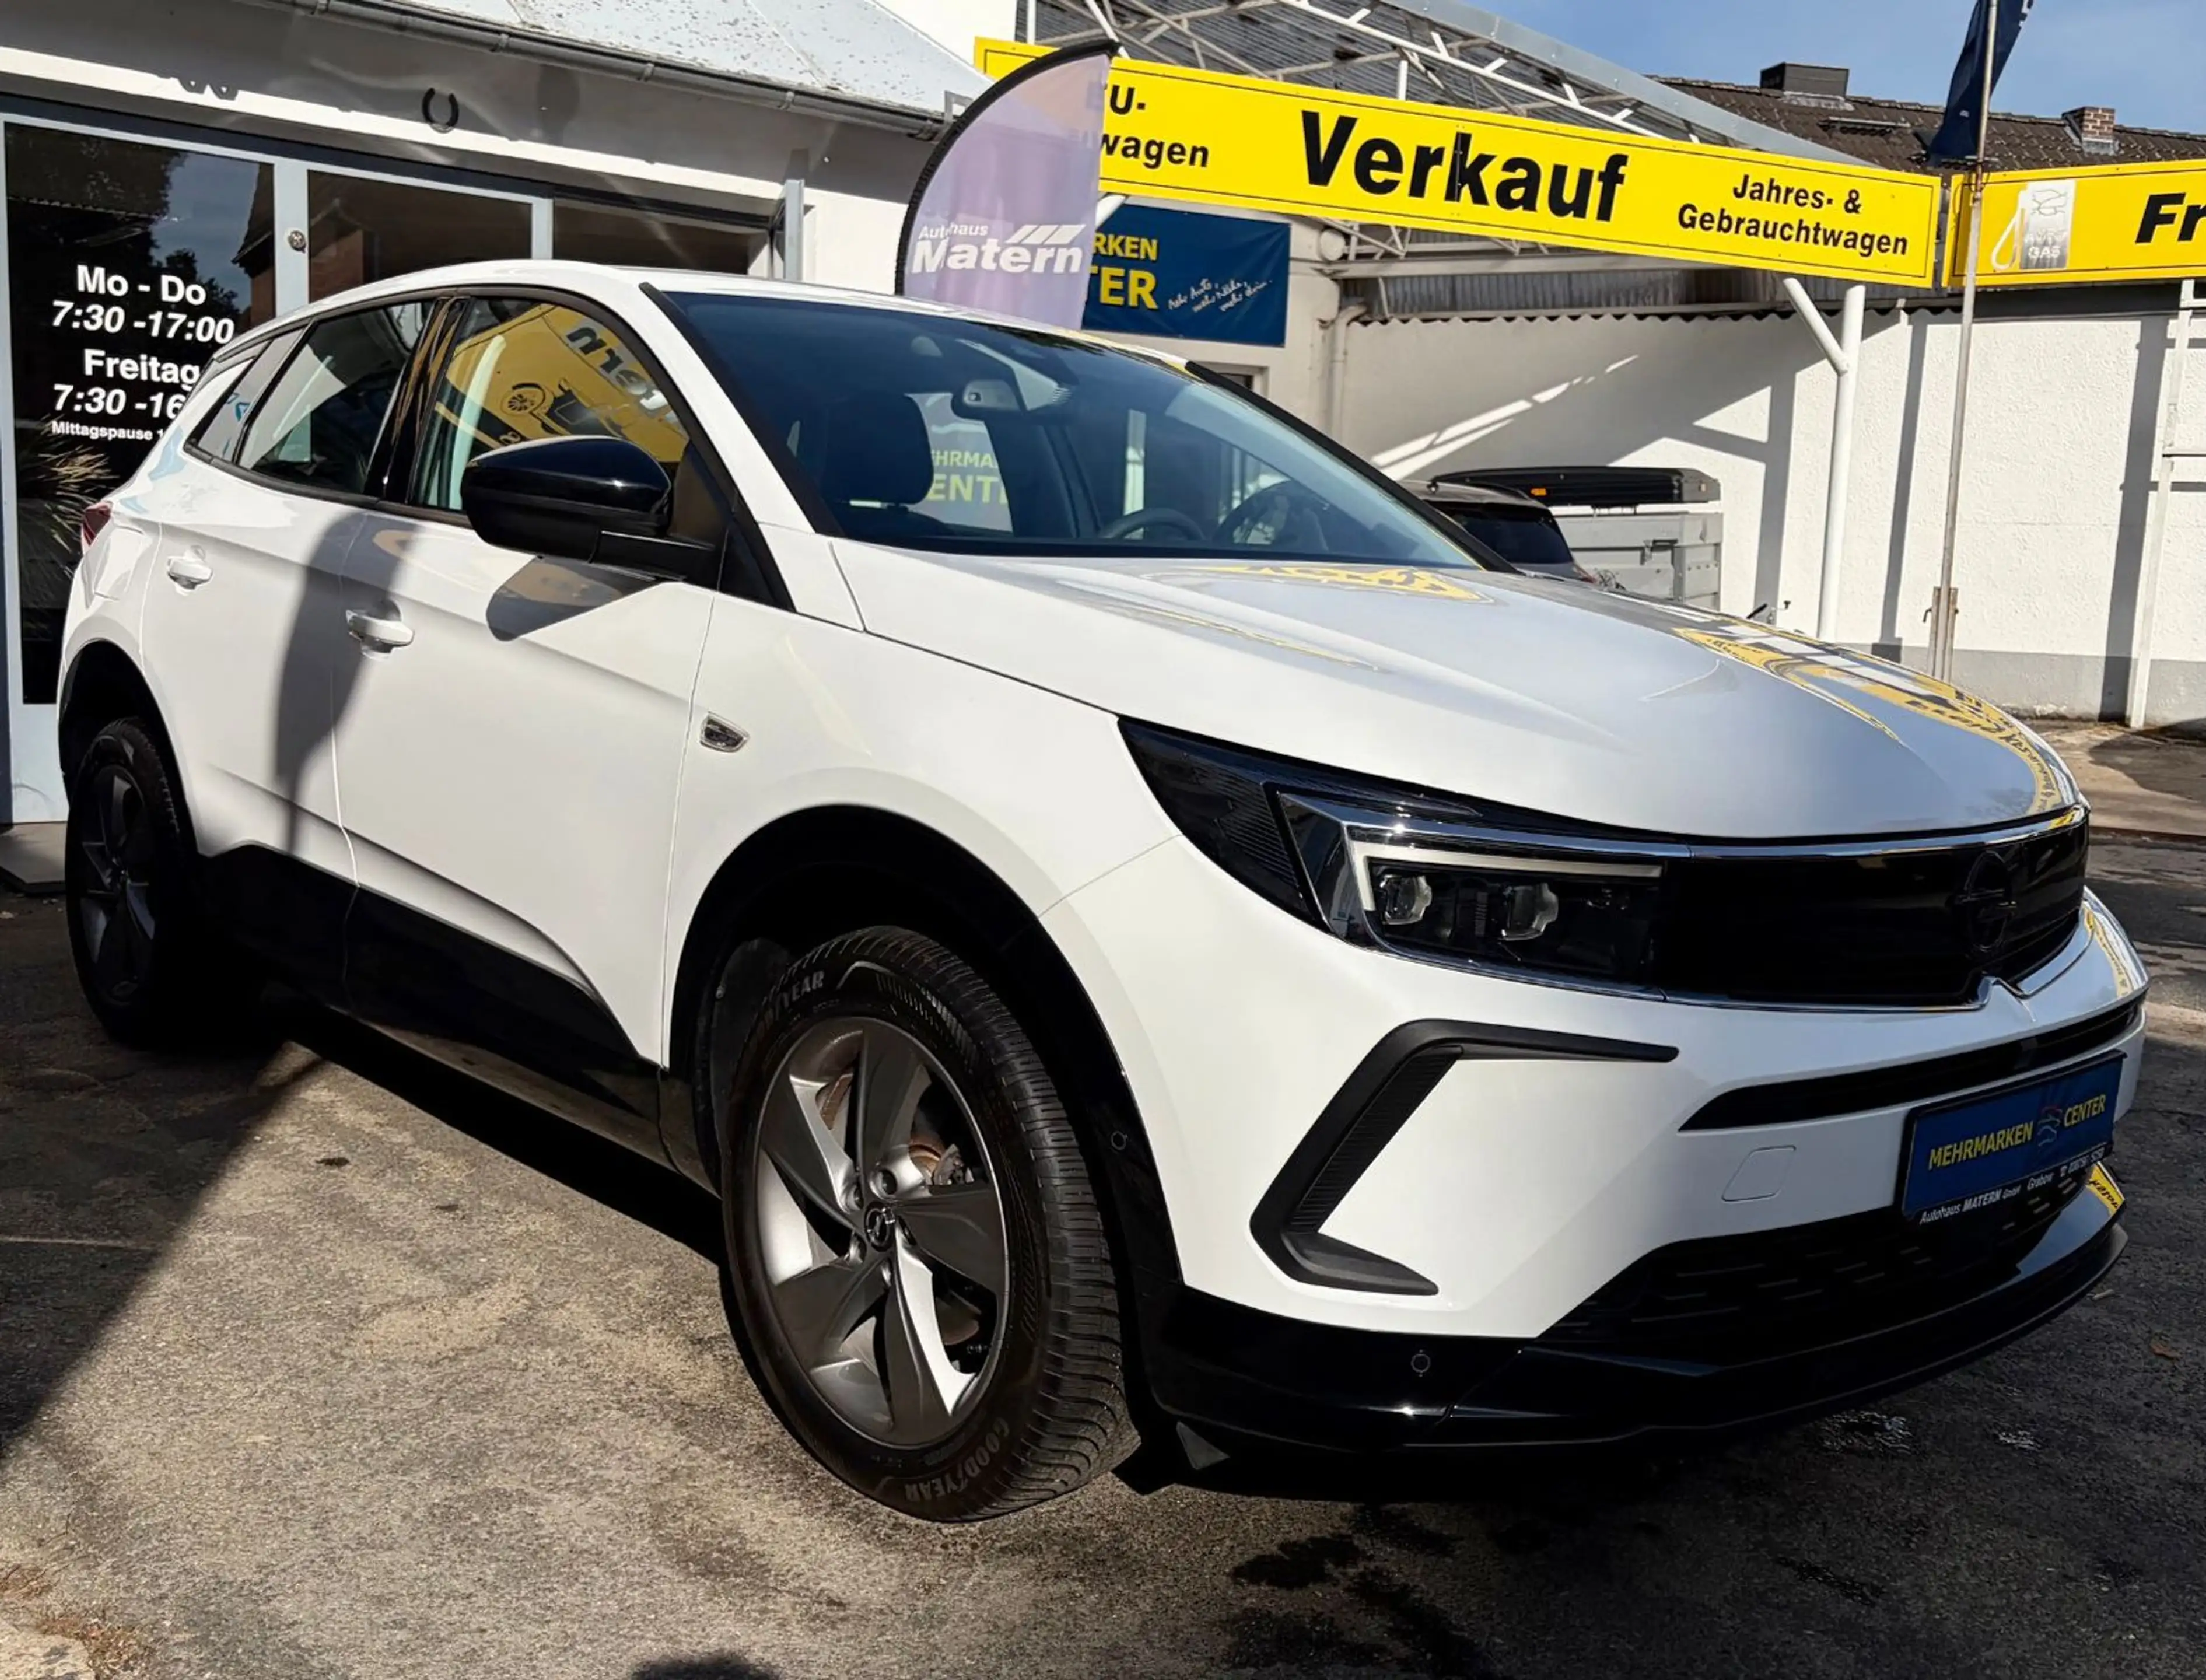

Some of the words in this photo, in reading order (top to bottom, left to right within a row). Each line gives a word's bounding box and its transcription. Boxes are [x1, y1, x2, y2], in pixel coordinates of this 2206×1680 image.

[1104, 83, 1146, 115] U-
[1301, 110, 1629, 223] Verkauf
[1732, 174, 1833, 209] Jahres-
[1843, 189, 1862, 214] &
[1678, 203, 1908, 257] Gebrauchtwagen
[911, 237, 1083, 274] Matern
[2028, 246, 2061, 258] GAS
[76, 264, 129, 296] Mo
[160, 274, 206, 306] Do
[52, 299, 125, 333] 7:30
[133, 310, 234, 344] -17:00
[84, 349, 200, 391] Freitag
[53, 383, 127, 415] 7:30
[51, 420, 153, 440] Mittagspause
[1928, 1122, 2033, 1170] MEHRMARKEN
[2063, 1094, 2106, 1128] CENTER
[1919, 1203, 1961, 1225] Autohaus
[1962, 1188, 2002, 1212] MATERN
[905, 1418, 1010, 1502] GOODYEAR
